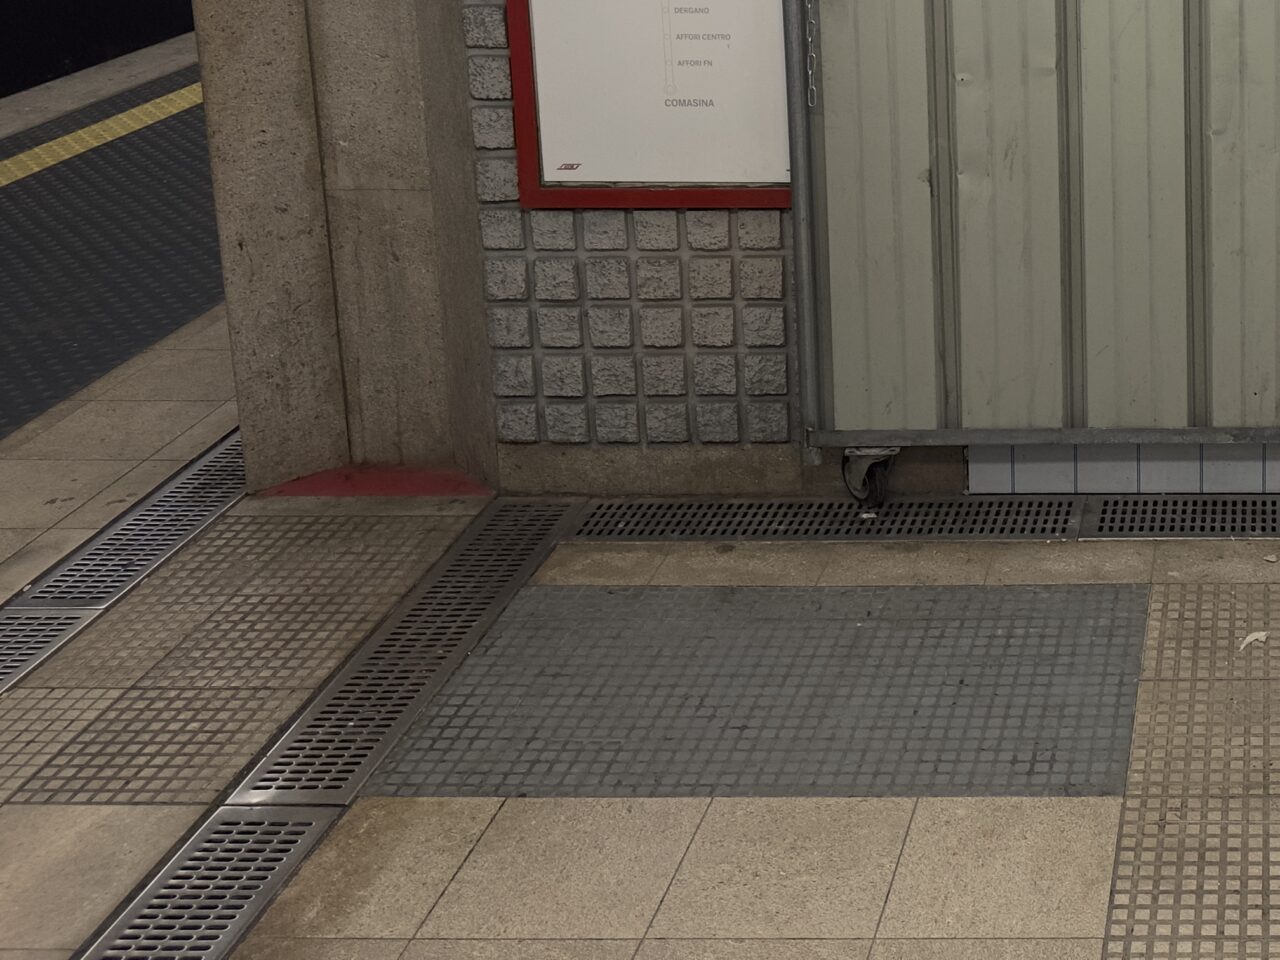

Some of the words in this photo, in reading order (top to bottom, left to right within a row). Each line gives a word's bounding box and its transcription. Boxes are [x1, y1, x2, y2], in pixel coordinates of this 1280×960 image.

[674, 7, 709, 15] DERGANO
[676, 33, 700, 41] AFFORI
[702, 33, 731, 41] CENTRO
[677, 59, 702, 67] AFFORI
[703, 59, 713, 67] FN
[664, 98, 714, 108] COMASINA
